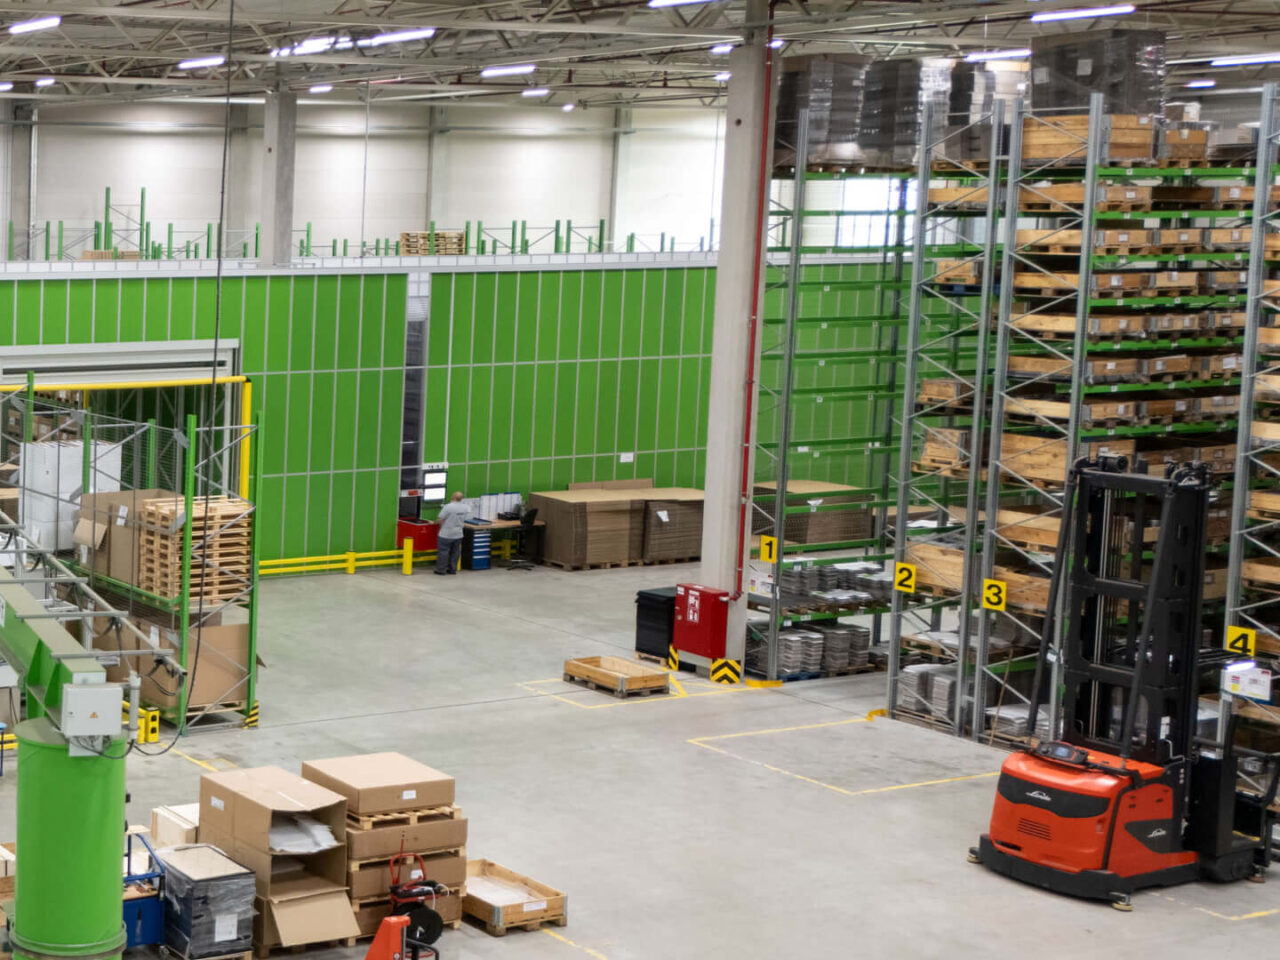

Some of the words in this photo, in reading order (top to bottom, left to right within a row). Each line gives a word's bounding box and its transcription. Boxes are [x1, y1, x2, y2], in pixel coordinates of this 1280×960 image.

[764, 541, 773, 559] 1
[897, 567, 913, 588] 2
[985, 584, 1003, 606] 3
[1229, 633, 1252, 653] 4
